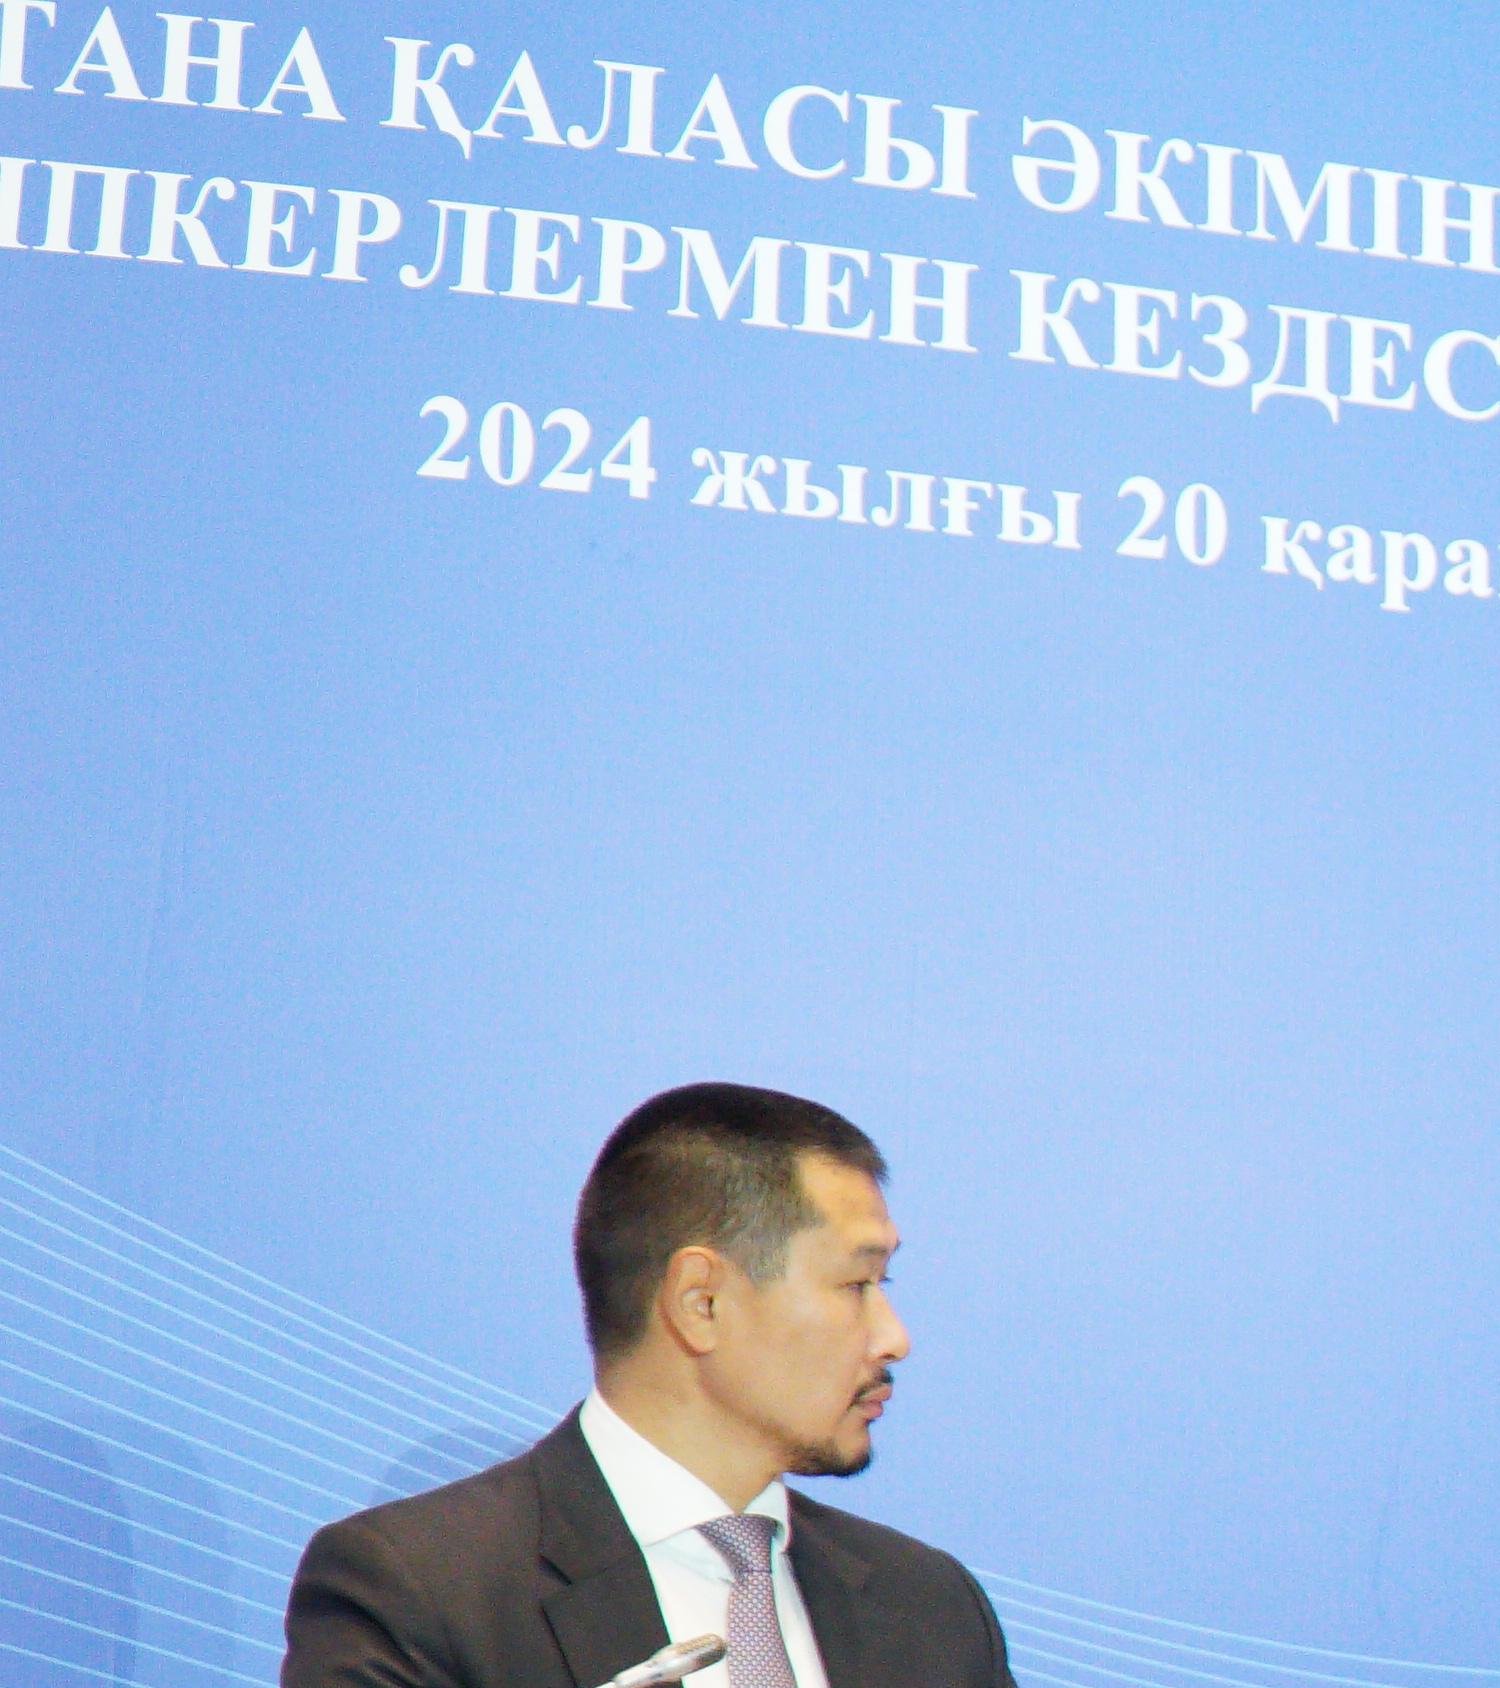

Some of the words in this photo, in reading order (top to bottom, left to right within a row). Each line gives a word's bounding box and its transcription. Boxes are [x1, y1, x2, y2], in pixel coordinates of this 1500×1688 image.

[380, 36, 979, 199] ҚАЛАСЫ
[416, 395, 658, 500] 2024
[690, 446, 1083, 552] жылғы
[1115, 476, 1229, 567] 20
